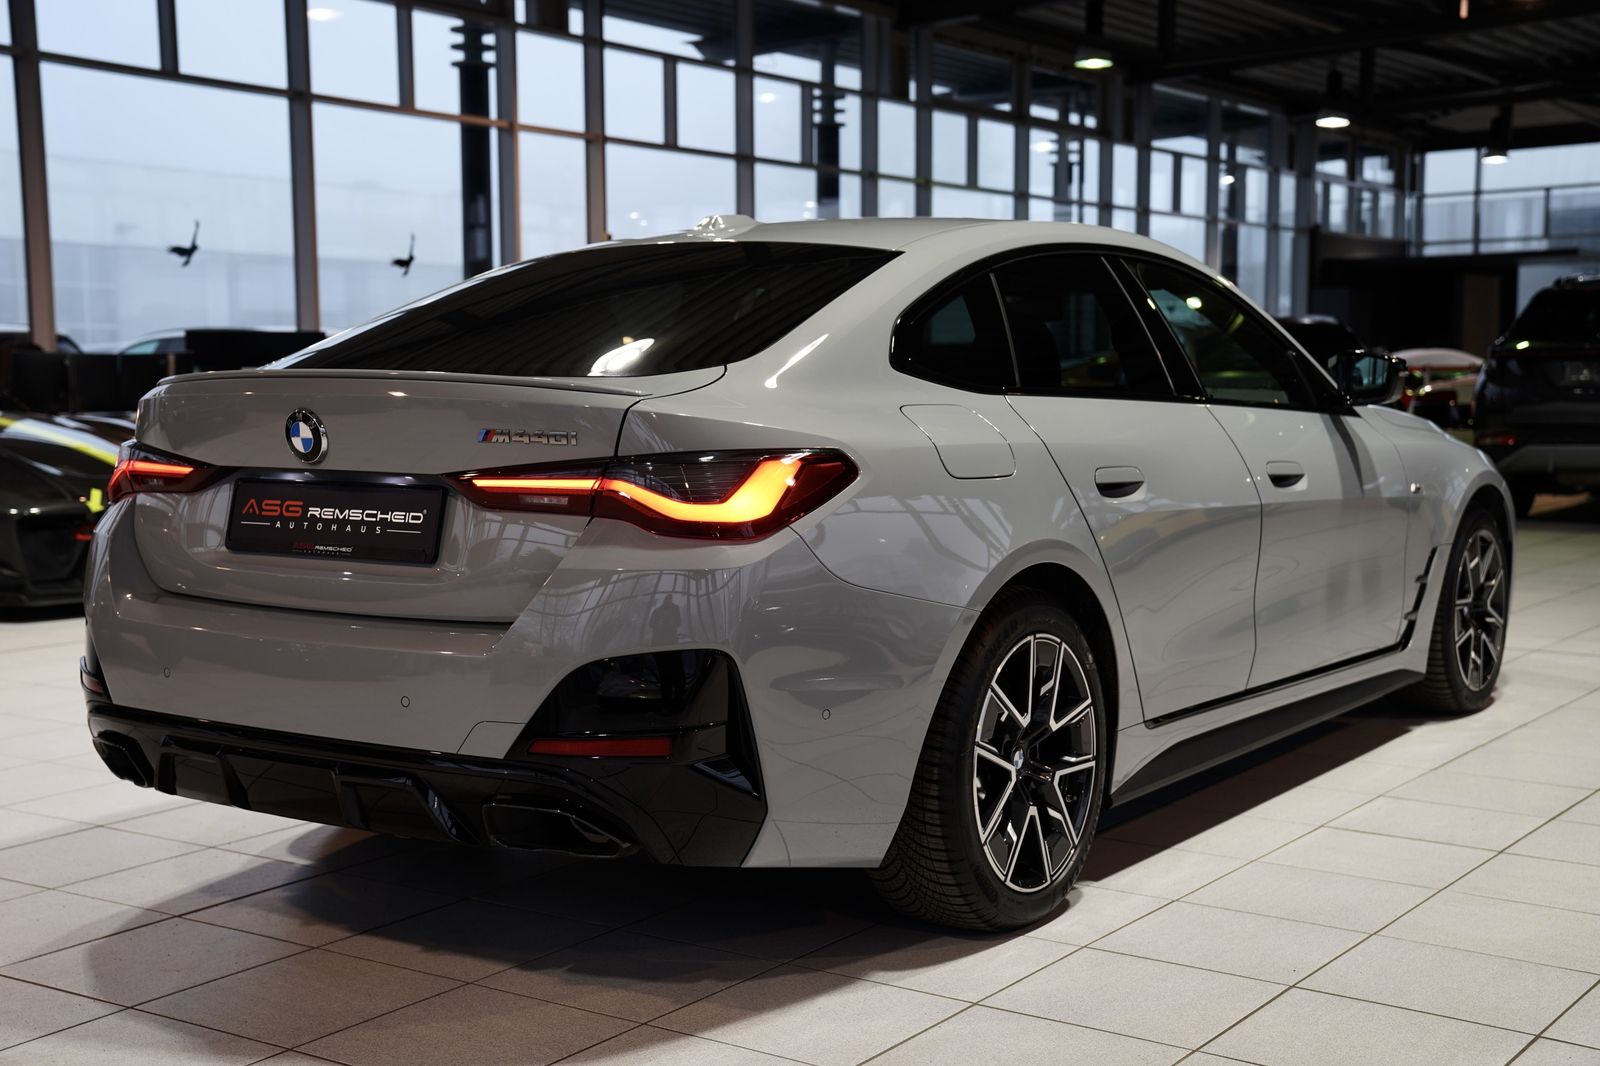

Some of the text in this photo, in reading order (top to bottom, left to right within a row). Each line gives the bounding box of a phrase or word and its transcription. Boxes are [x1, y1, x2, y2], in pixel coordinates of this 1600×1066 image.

[491, 428, 577, 445] M440i
[242, 498, 424, 523] ASG REMSCHEID
[275, 520, 381, 534] AUTOHAUS
